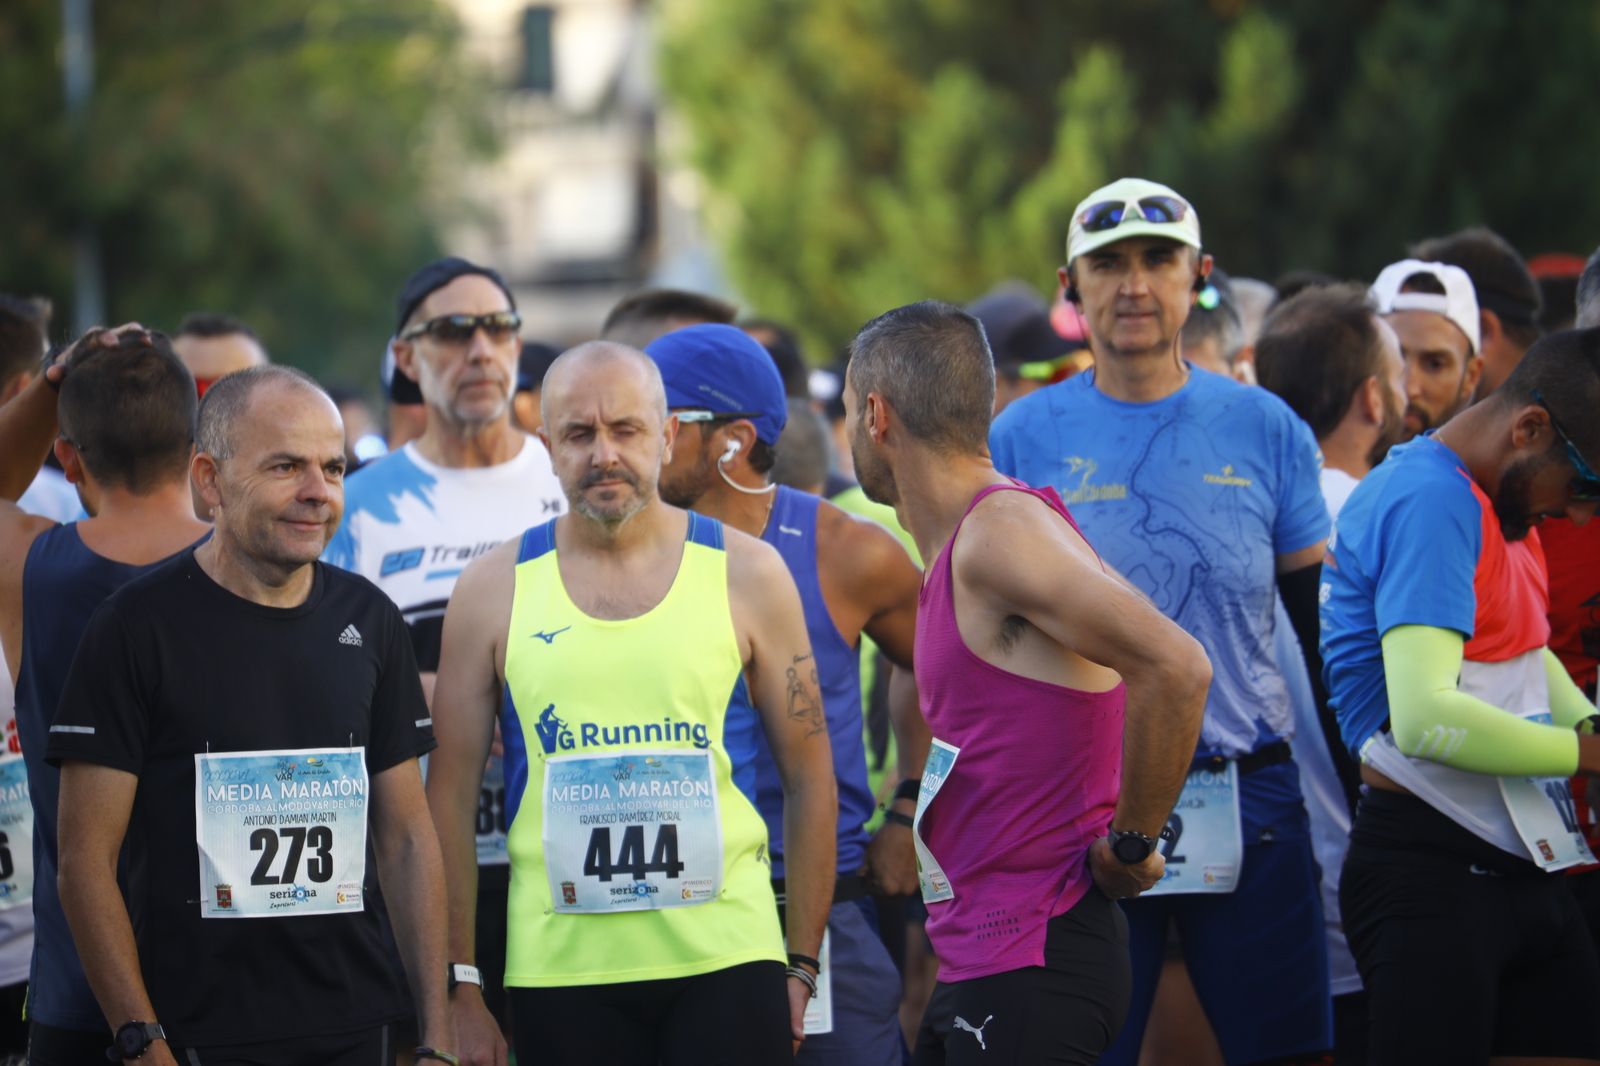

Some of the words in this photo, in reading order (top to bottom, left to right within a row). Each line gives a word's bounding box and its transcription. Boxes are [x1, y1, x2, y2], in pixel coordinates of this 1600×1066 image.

[580, 717, 711, 749] Running
[207, 783, 273, 802] MEDIA
[281, 774, 363, 799] MARATÓN
[551, 783, 612, 803] MEDIA
[618, 775, 709, 798] MARATÓN
[332, 799, 347, 809] DEL
[243, 814, 277, 826] ANTONIO
[249, 825, 334, 886] 273
[583, 824, 685, 882] 444
